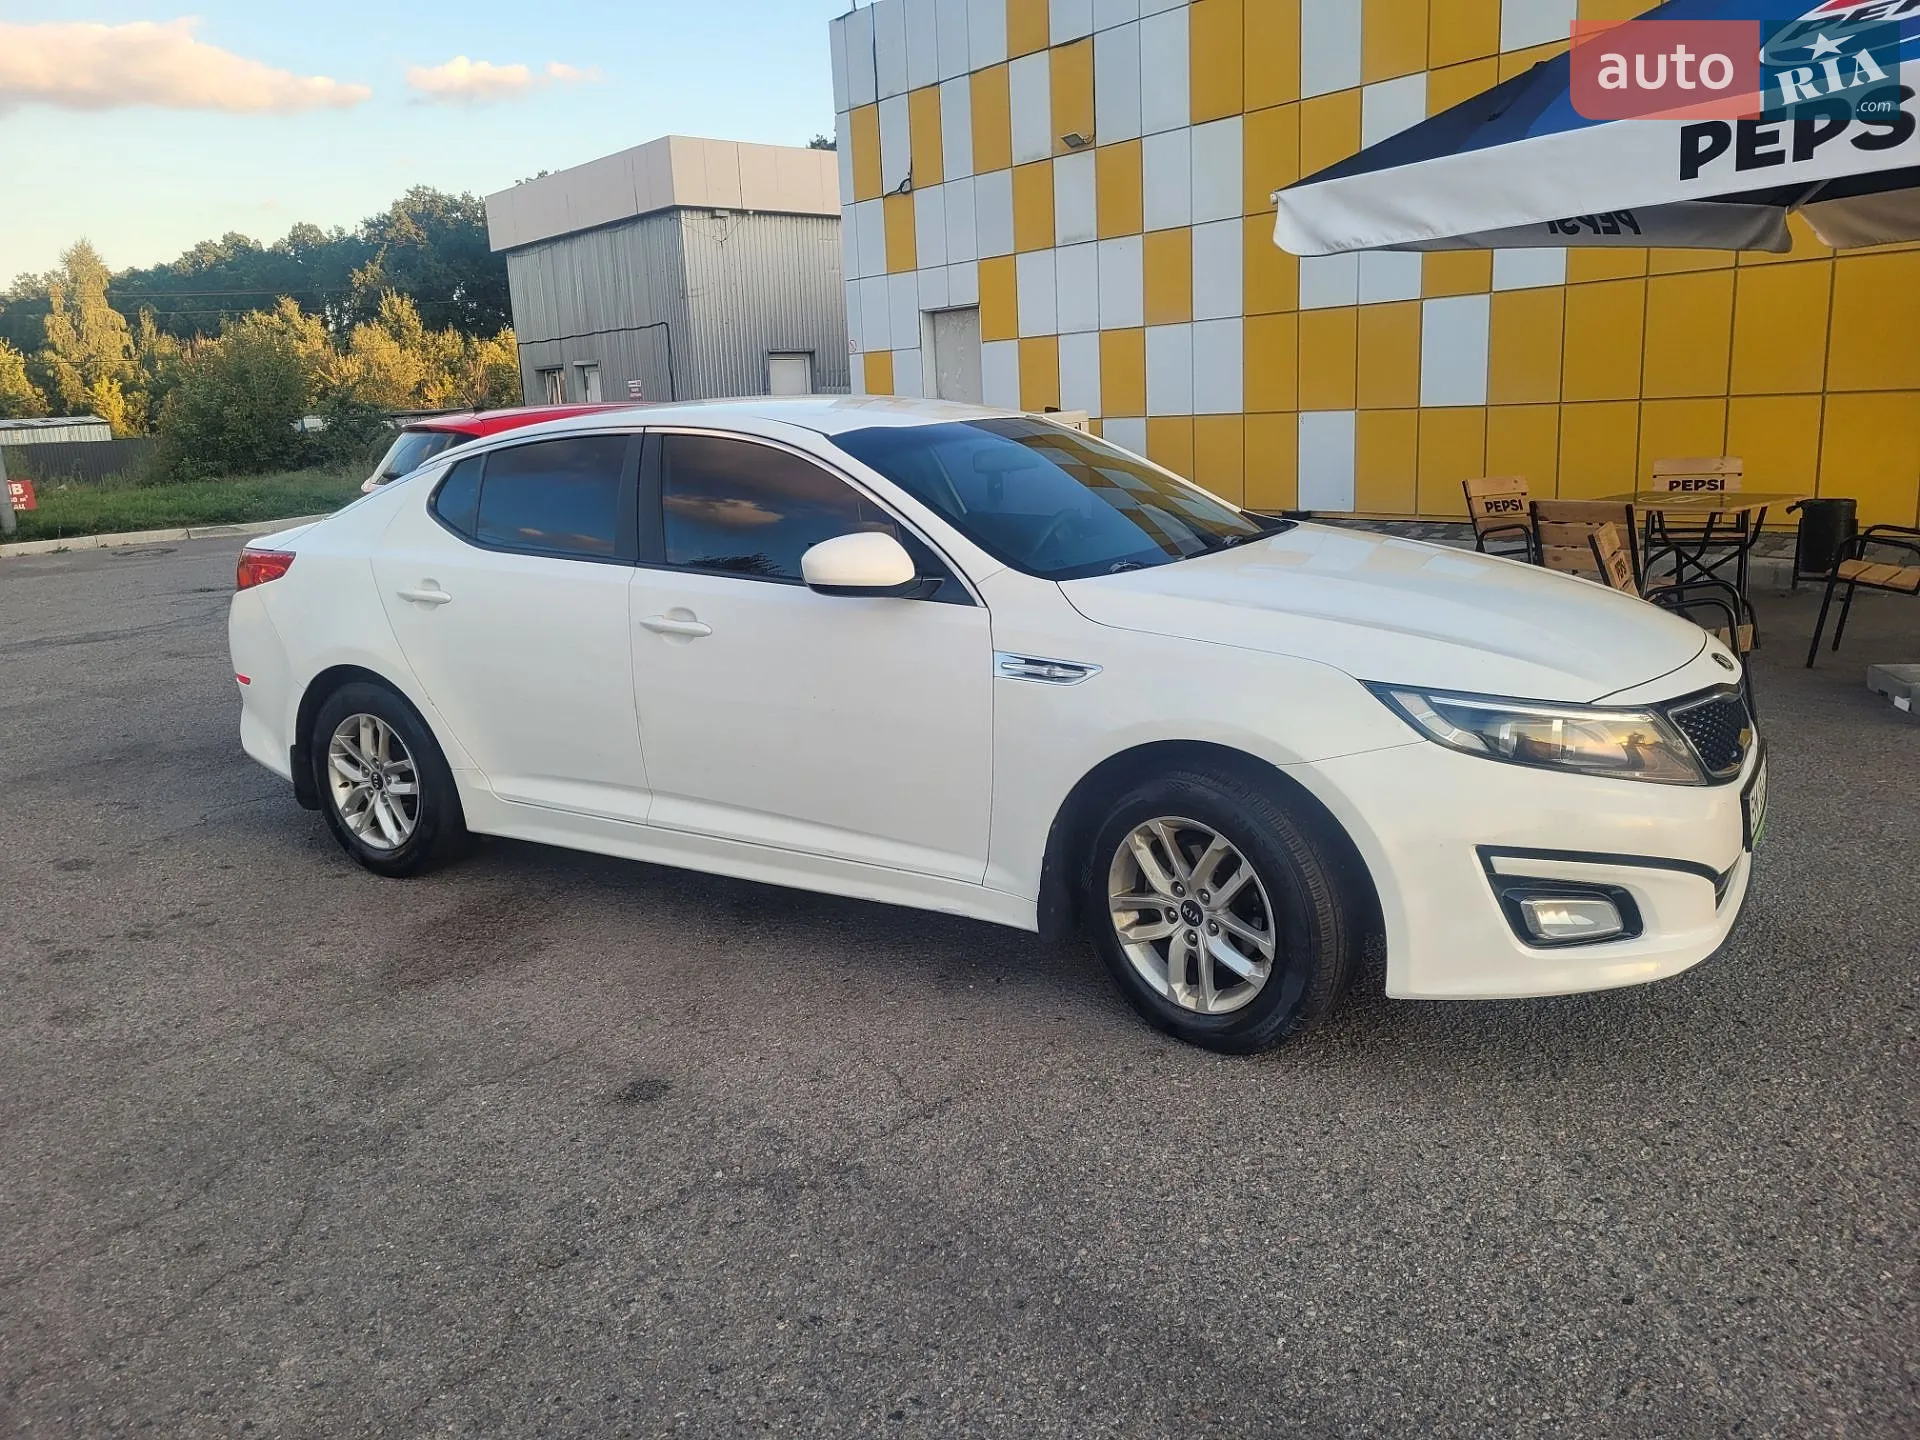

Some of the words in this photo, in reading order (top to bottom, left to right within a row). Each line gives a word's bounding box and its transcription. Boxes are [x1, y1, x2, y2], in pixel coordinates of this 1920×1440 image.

[1668, 479, 1726, 492] PEPSI
[1484, 498, 1524, 513] PEPSI
[1182, 904, 1200, 924] KIA
